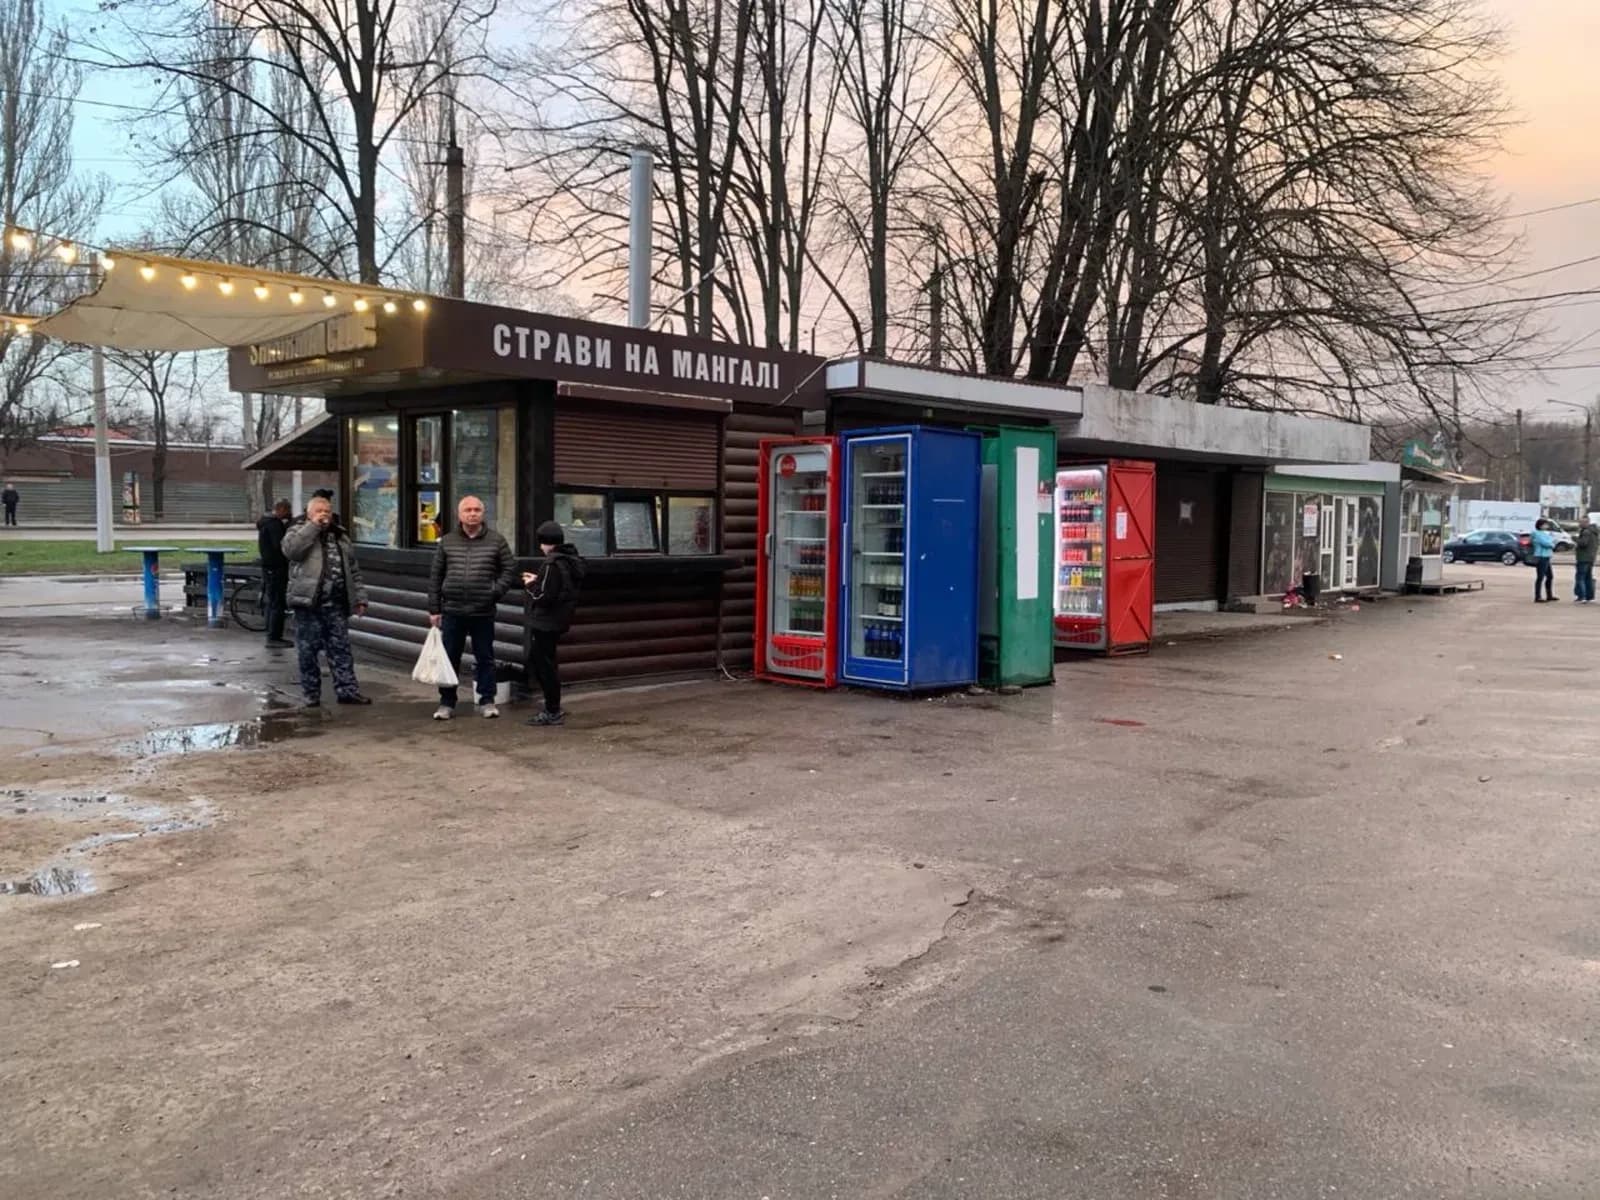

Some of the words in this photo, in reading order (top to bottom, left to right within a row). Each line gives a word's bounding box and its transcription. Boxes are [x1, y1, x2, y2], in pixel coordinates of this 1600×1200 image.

[493, 323, 612, 369] СТРАВИ
[625, 343, 660, 375] НА
[672, 350, 780, 390] МАНГАЛІ
